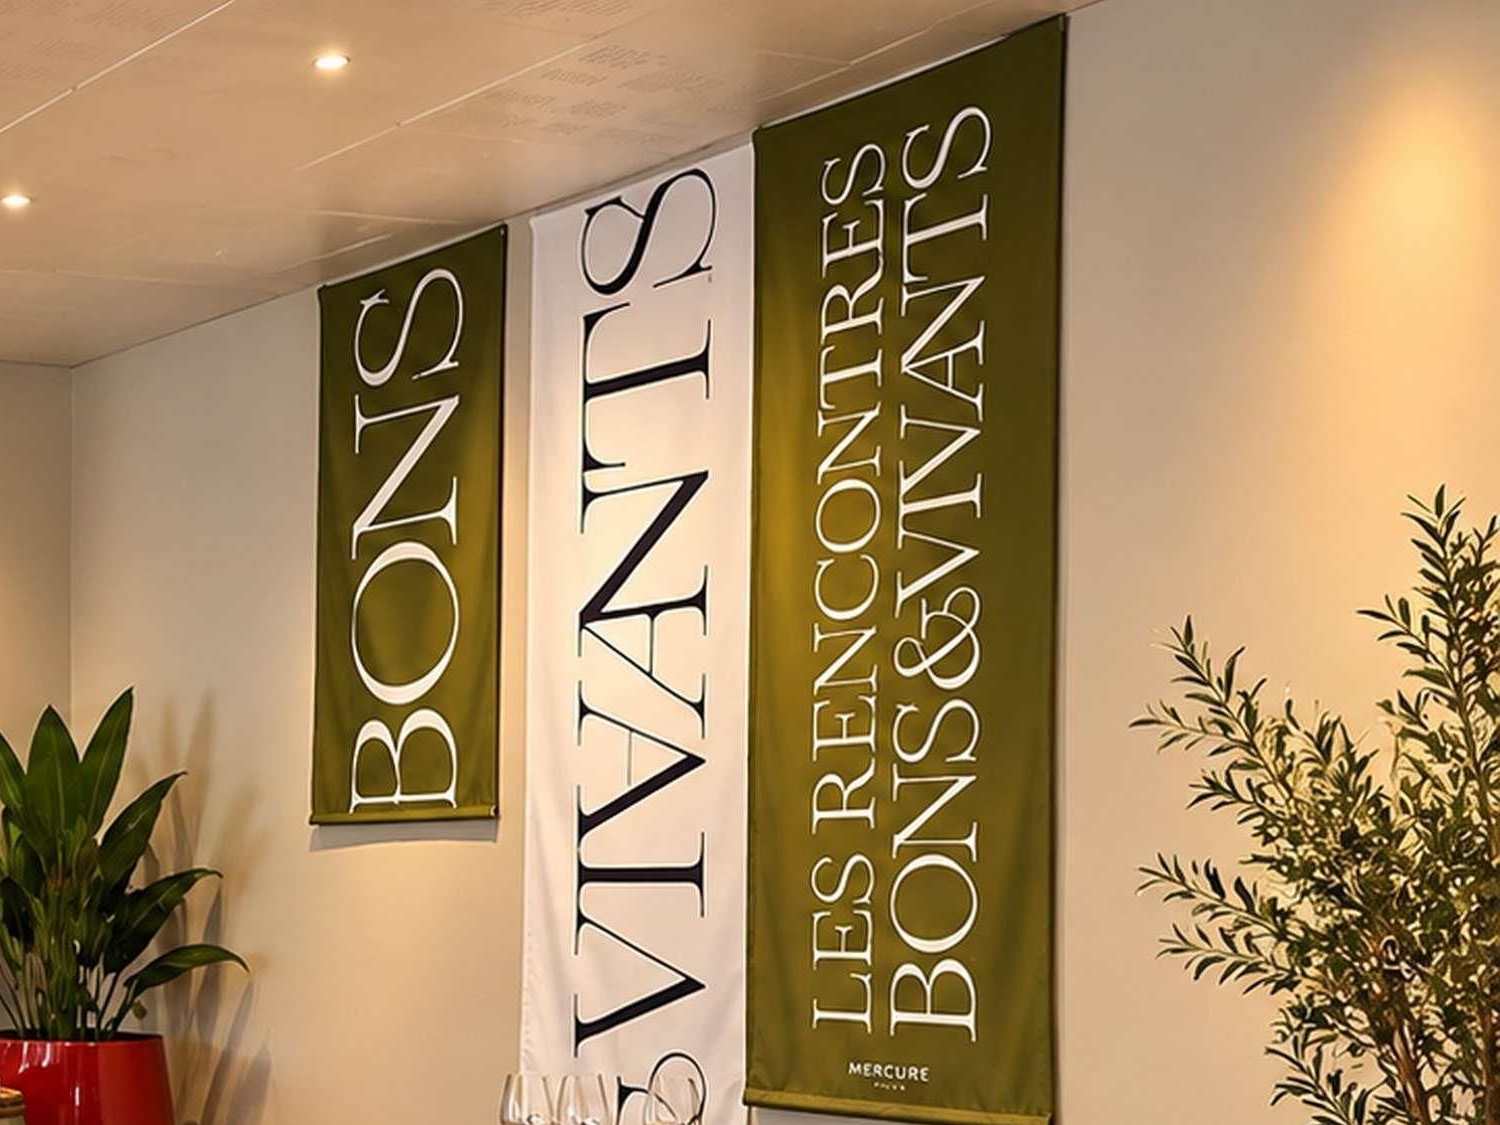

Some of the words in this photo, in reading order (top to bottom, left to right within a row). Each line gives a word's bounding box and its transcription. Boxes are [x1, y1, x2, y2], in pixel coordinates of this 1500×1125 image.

[349, 267, 464, 813] BONS
[812, 142, 886, 834] RENCONTRES
[812, 854, 876, 1033] LES
[848, 1062, 930, 1083] MERCURE
